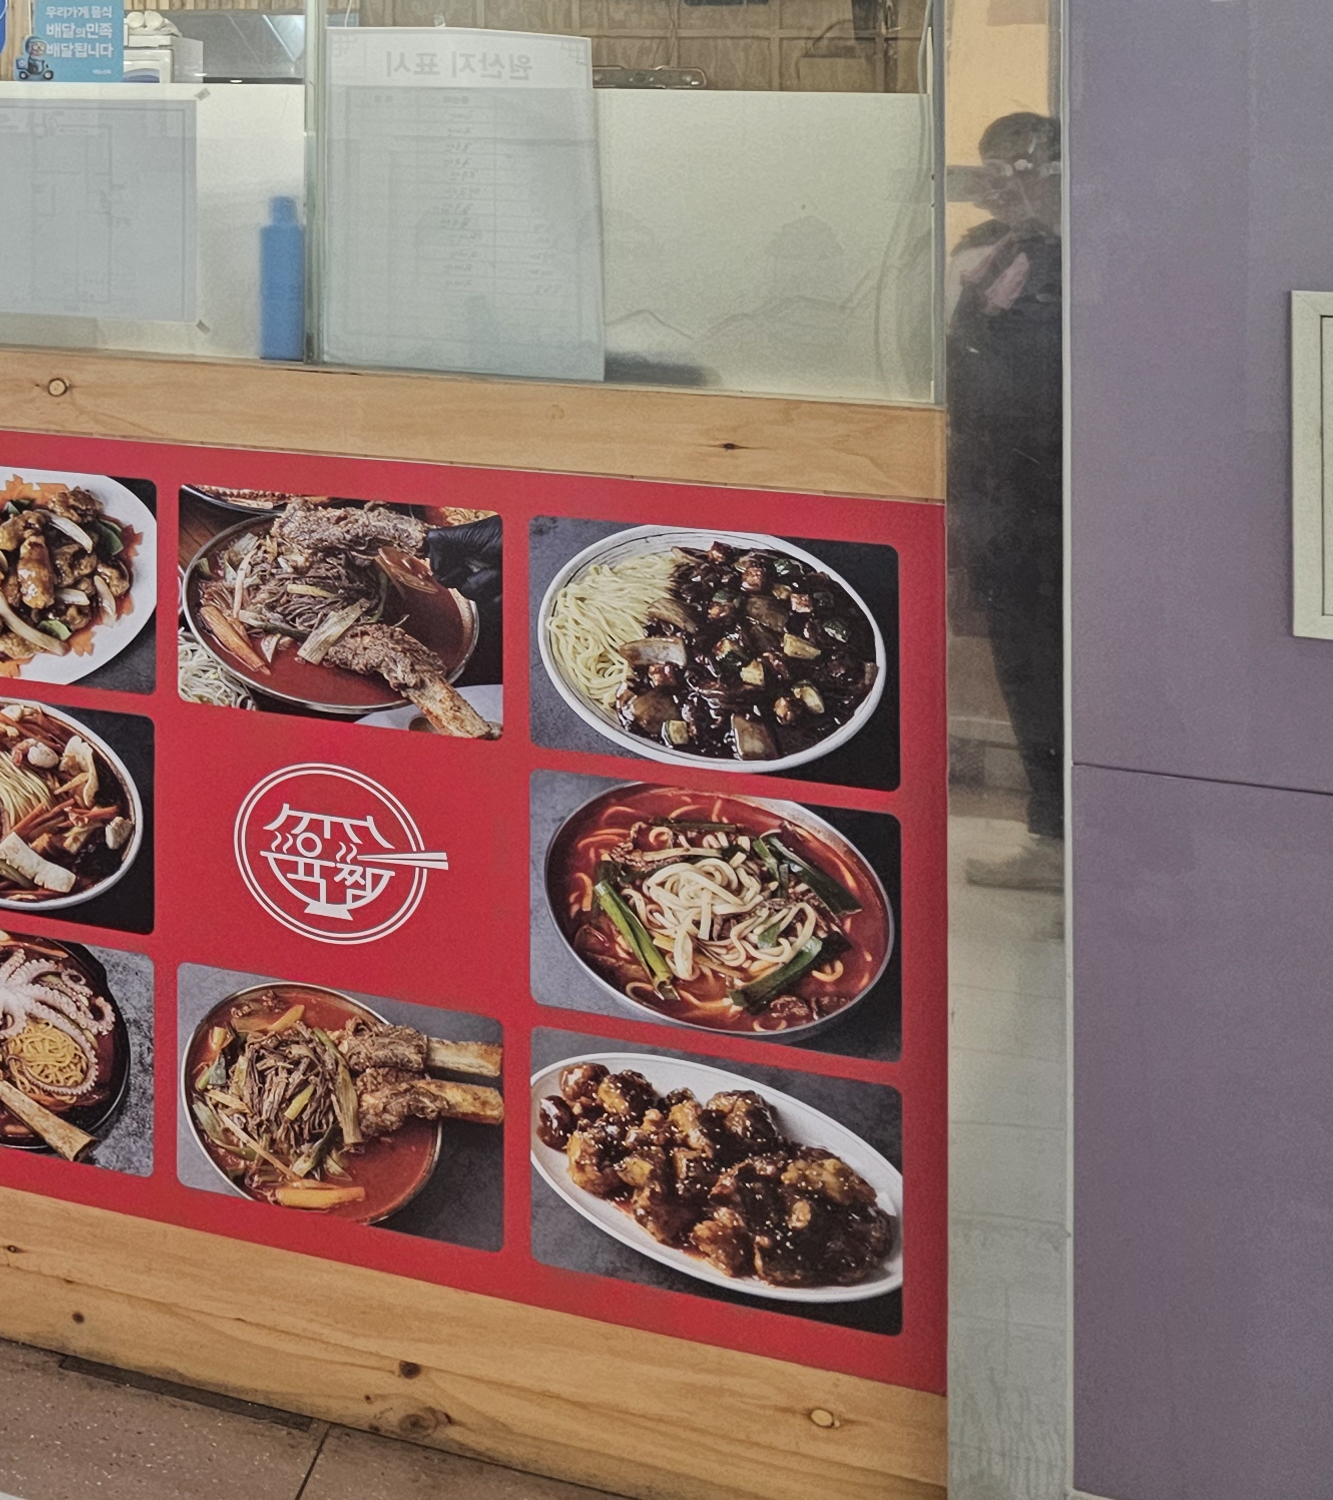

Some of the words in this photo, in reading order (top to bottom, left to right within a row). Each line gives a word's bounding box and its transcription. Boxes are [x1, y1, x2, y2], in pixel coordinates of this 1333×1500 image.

[46, 6, 89, 19] 우리가게
[91, 6, 112, 18] 음식
[46, 22, 112, 38] 배달의민족
[46, 43, 114, 58] 배달됩니다
